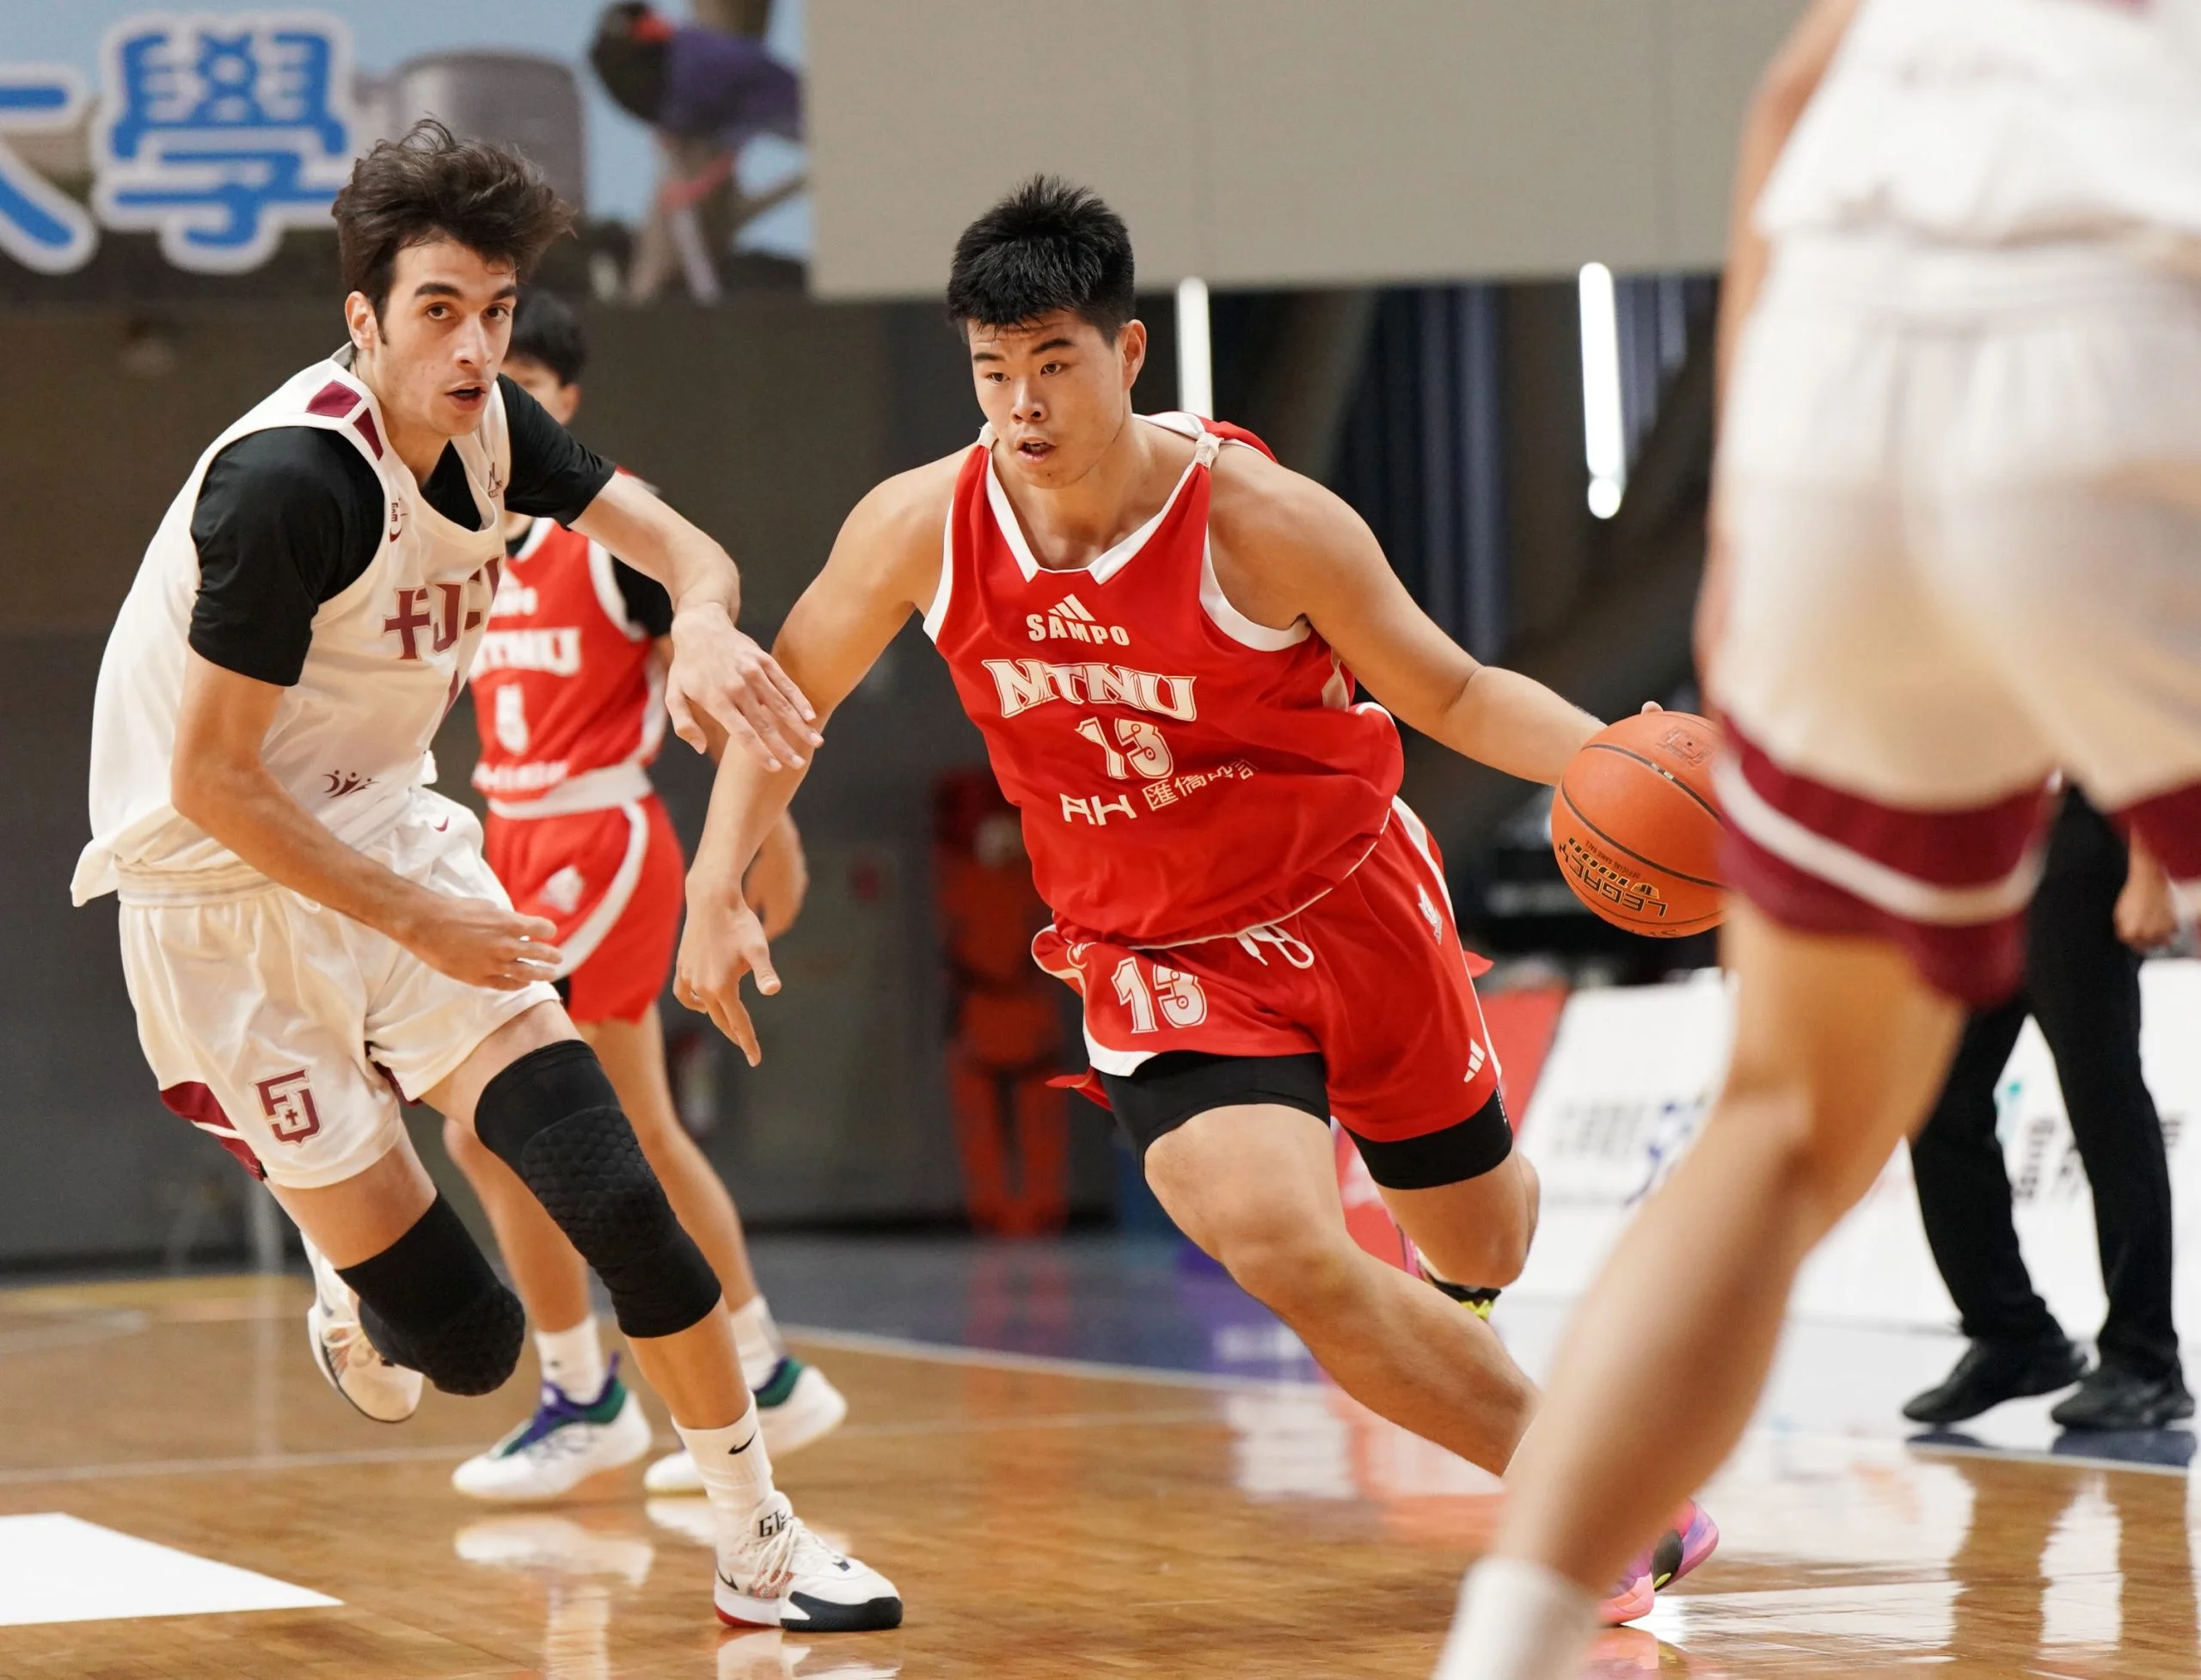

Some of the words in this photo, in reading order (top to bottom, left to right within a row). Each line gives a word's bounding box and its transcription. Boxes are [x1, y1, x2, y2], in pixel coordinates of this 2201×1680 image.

[1026, 613, 1131, 646] SAMPO
[1075, 716, 1174, 780] 13
[1558, 841, 1669, 918] LEGACY
[1110, 955, 1208, 1033] 13
